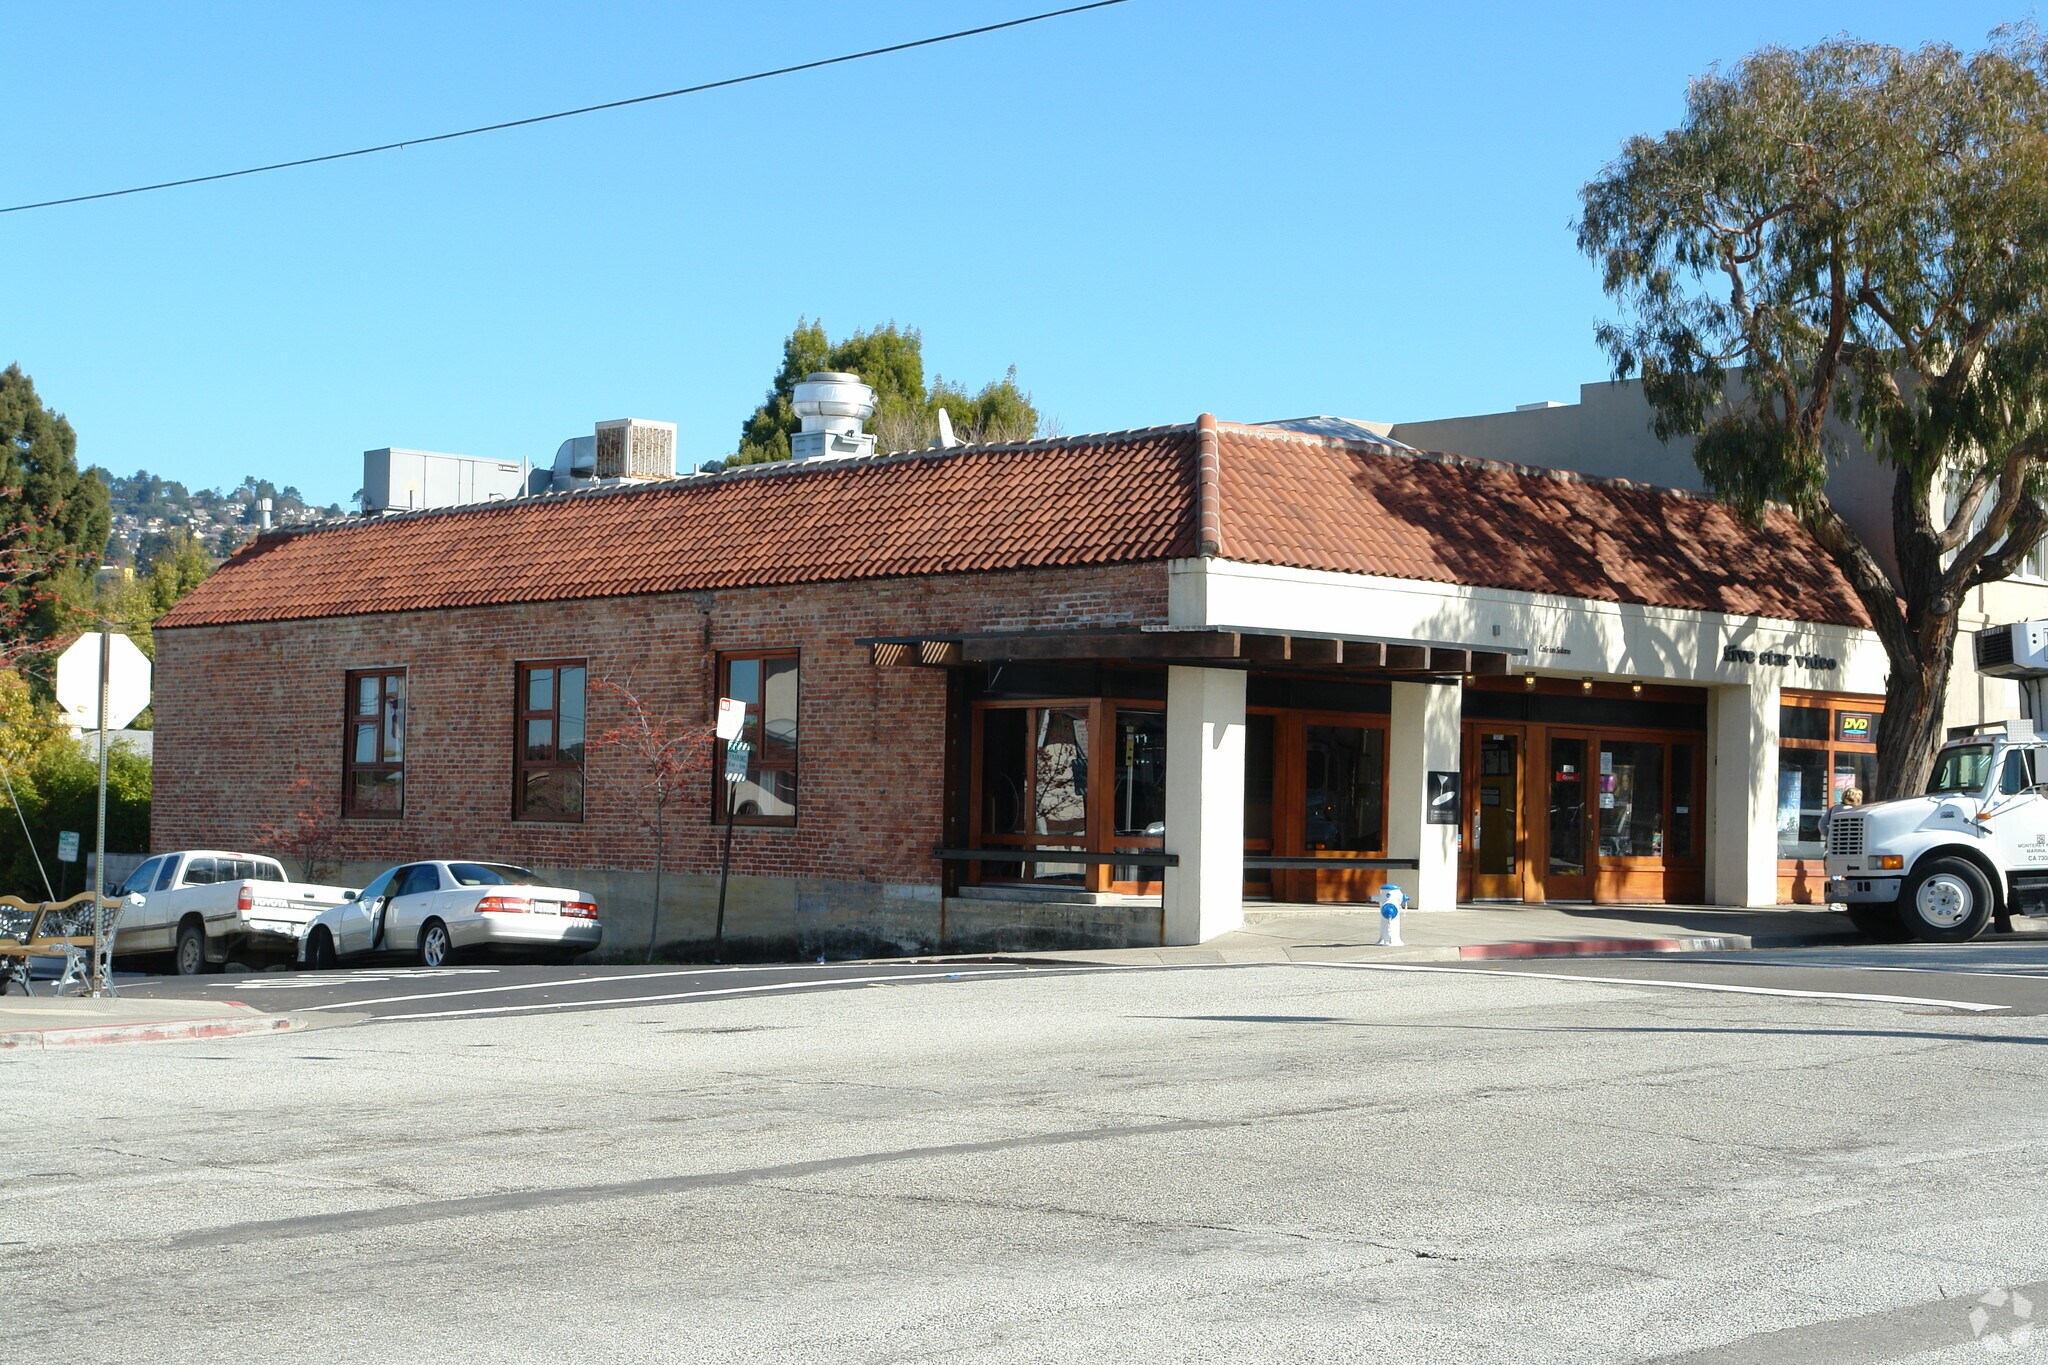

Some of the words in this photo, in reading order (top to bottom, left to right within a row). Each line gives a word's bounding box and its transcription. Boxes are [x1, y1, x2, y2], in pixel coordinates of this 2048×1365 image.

[1538, 644, 1549, 653] Cafe
[1724, 645, 1755, 664] five
[1758, 650, 1792, 667] star
[1795, 652, 1837, 670] video
[1843, 717, 1868, 730] DVD
[254, 897, 289, 908] TOYOTA
